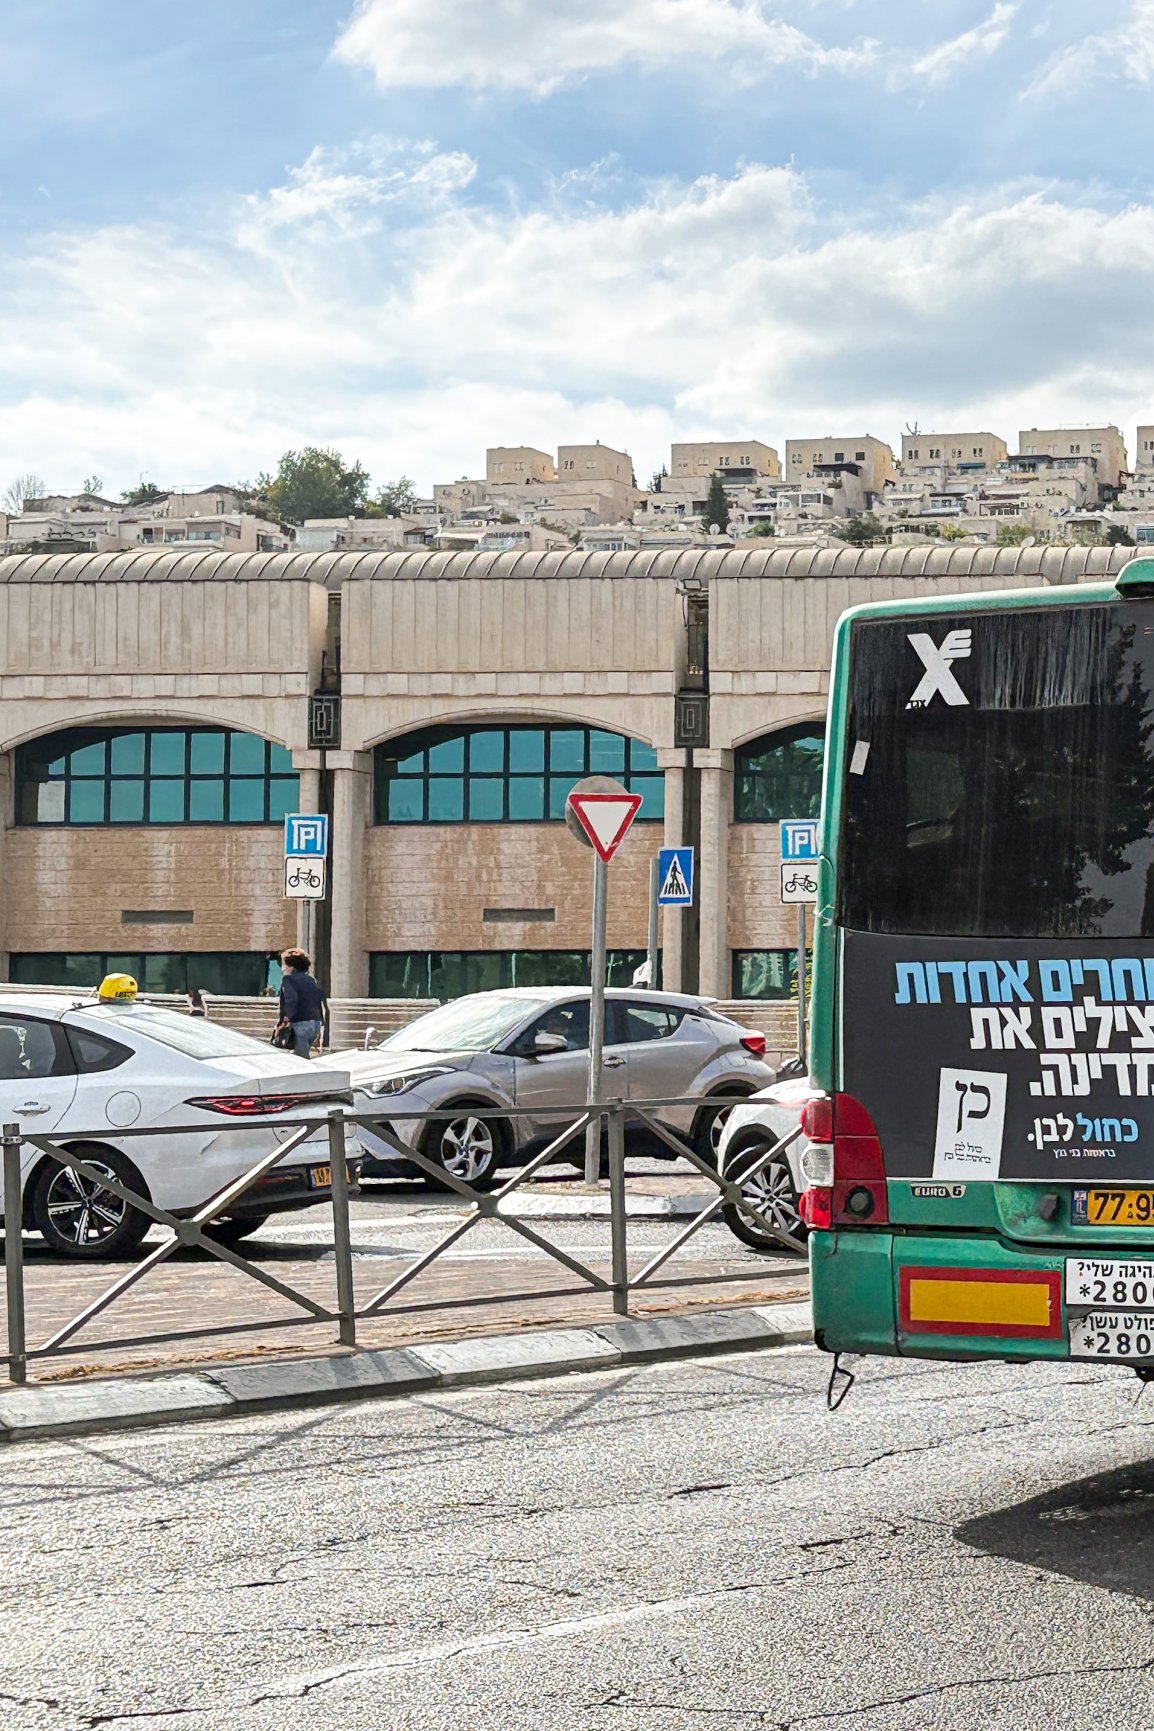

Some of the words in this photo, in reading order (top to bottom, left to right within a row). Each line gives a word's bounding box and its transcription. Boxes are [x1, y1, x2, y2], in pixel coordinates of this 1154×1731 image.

[895, 960, 1034, 1004] אחדות
[970, 1006, 1037, 1049] את
[955, 1080, 991, 1134] כן
[1075, 1112, 1139, 1142] כחול
[1027, 1112, 1075, 1150] לבן.
[1077, 1262, 1114, 1277] שלי?
